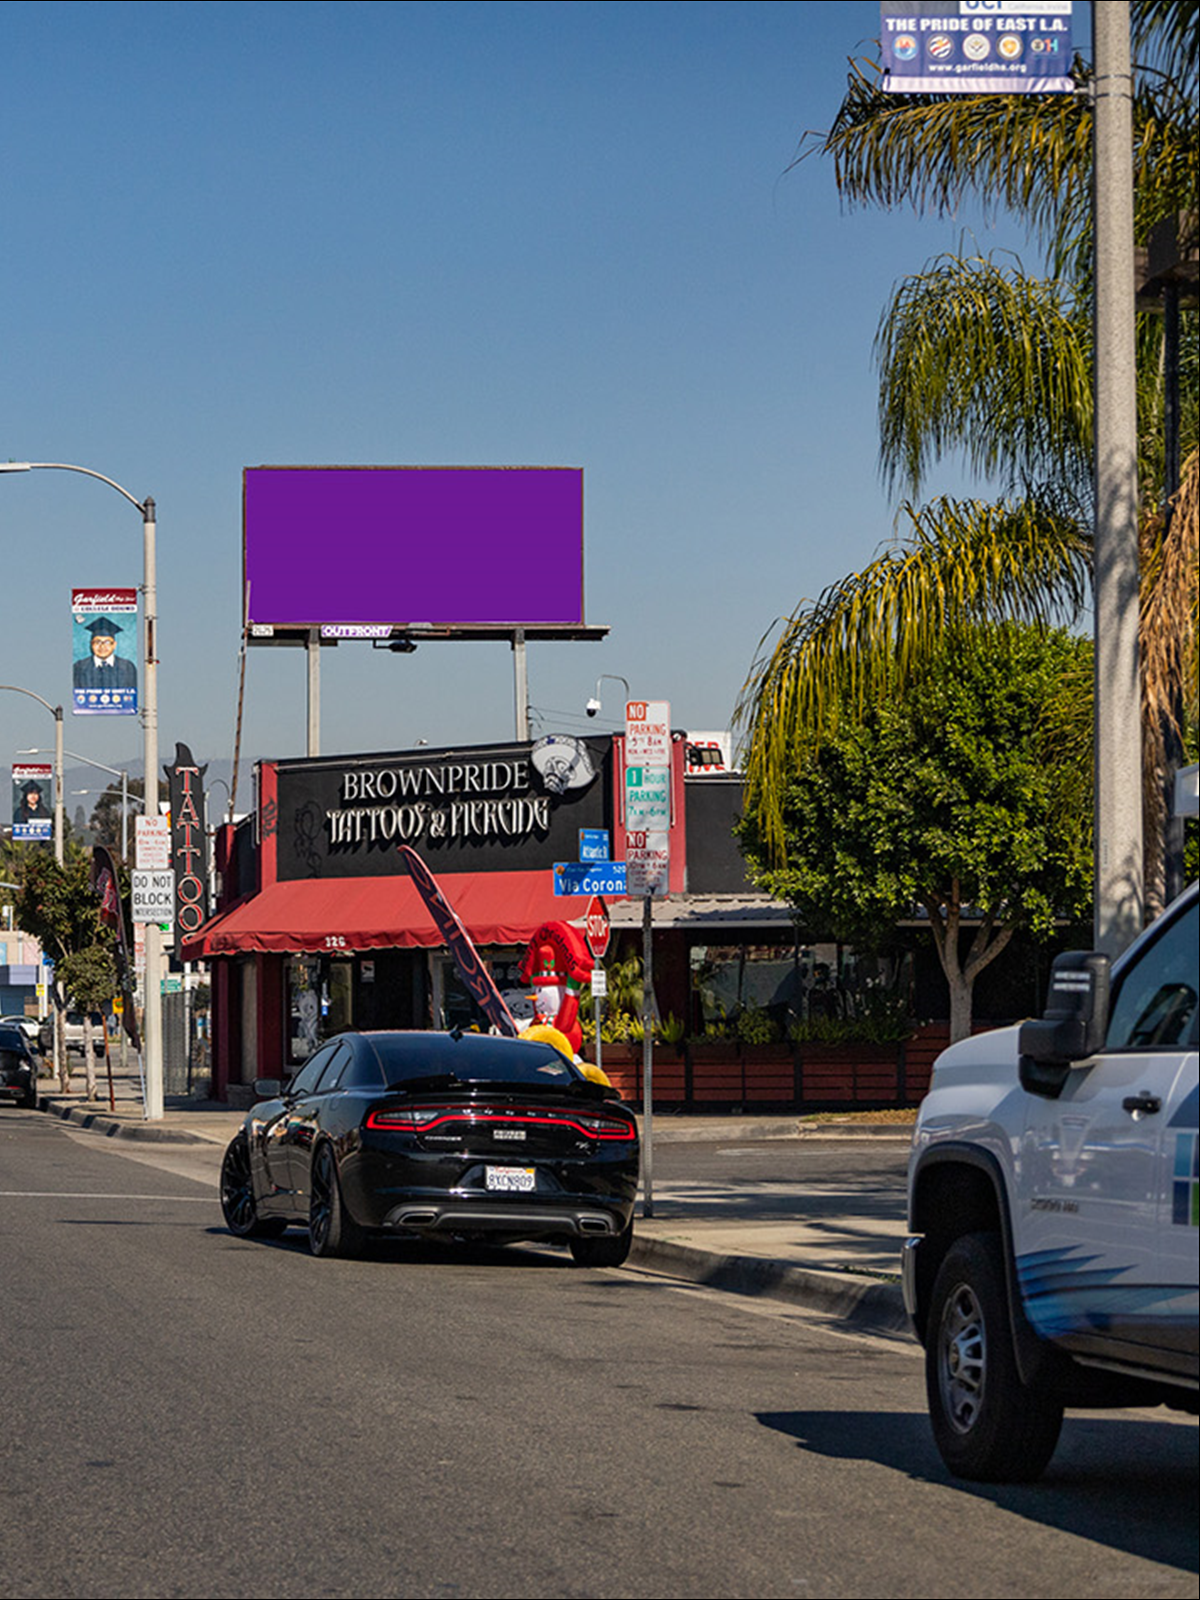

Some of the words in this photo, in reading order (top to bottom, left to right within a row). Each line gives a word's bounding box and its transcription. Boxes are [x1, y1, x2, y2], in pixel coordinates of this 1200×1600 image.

[886, 18, 917, 31] THE
[920, 18, 969, 31] PRIDE
[972, 18, 993, 31] OF
[996, 18, 1037, 31] EAST
[1039, 18, 1068, 31] L.A.
[629, 704, 644, 719] NO
[630, 723, 666, 736] PARKING
[343, 761, 529, 800] BROWNPRIDE
[632, 770, 637, 784] 1
[629, 790, 666, 802] PARKING
[145, 819, 158, 827] NO
[326, 803, 427, 843] TATTOOS
[430, 810, 446, 838] &
[451, 797, 550, 837] PIERCING
[137, 829, 167, 837] PARKING
[627, 833, 644, 847] NO
[628, 850, 668, 861] PARKING
[133, 876, 148, 888] DO
[152, 876, 171, 888] NOT
[559, 879, 579, 893] Via
[133, 892, 172, 905] BLOCK
[587, 914, 608, 937] STOP
